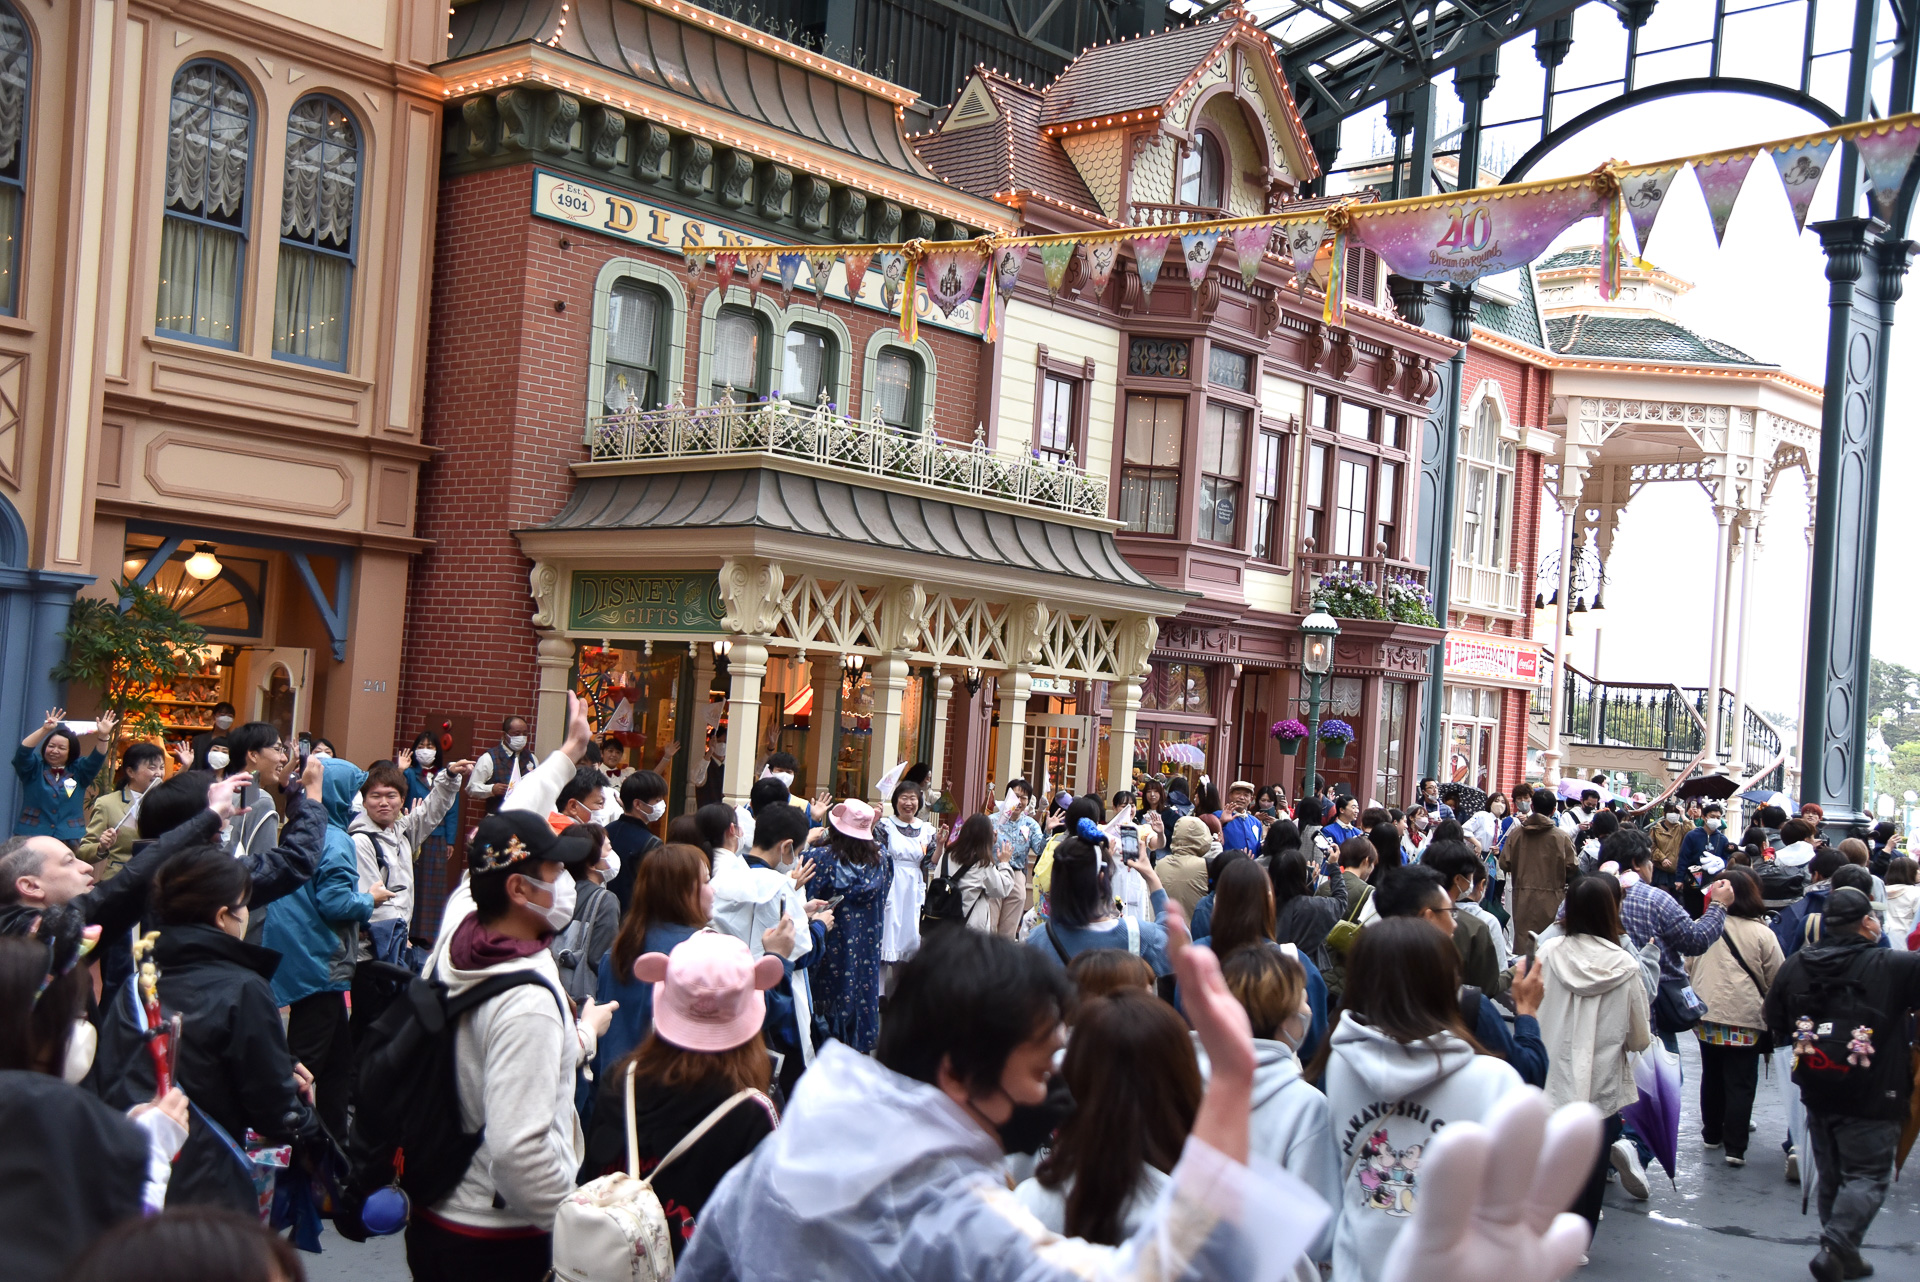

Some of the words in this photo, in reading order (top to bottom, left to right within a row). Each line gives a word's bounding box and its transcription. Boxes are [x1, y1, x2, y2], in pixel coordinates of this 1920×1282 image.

[566, 183, 583, 195] Est.
[558, 194, 588, 212] 1901
[1437, 206, 1492, 255] 40
[1429, 250, 1458, 268] Dream
[1459, 257, 1470, 267] Go
[1470, 240, 1502, 267] Round
[578, 577, 684, 619] DISNEY
[707, 577, 728, 621] C
[624, 608, 679, 626] GIFTS
[1453, 642, 1515, 673] REFRESHMENT
[1469, 660, 1499, 673] CORNER
[363, 679, 387, 692] 241
[1342, 1100, 1430, 1156] NAKAYOSHI
